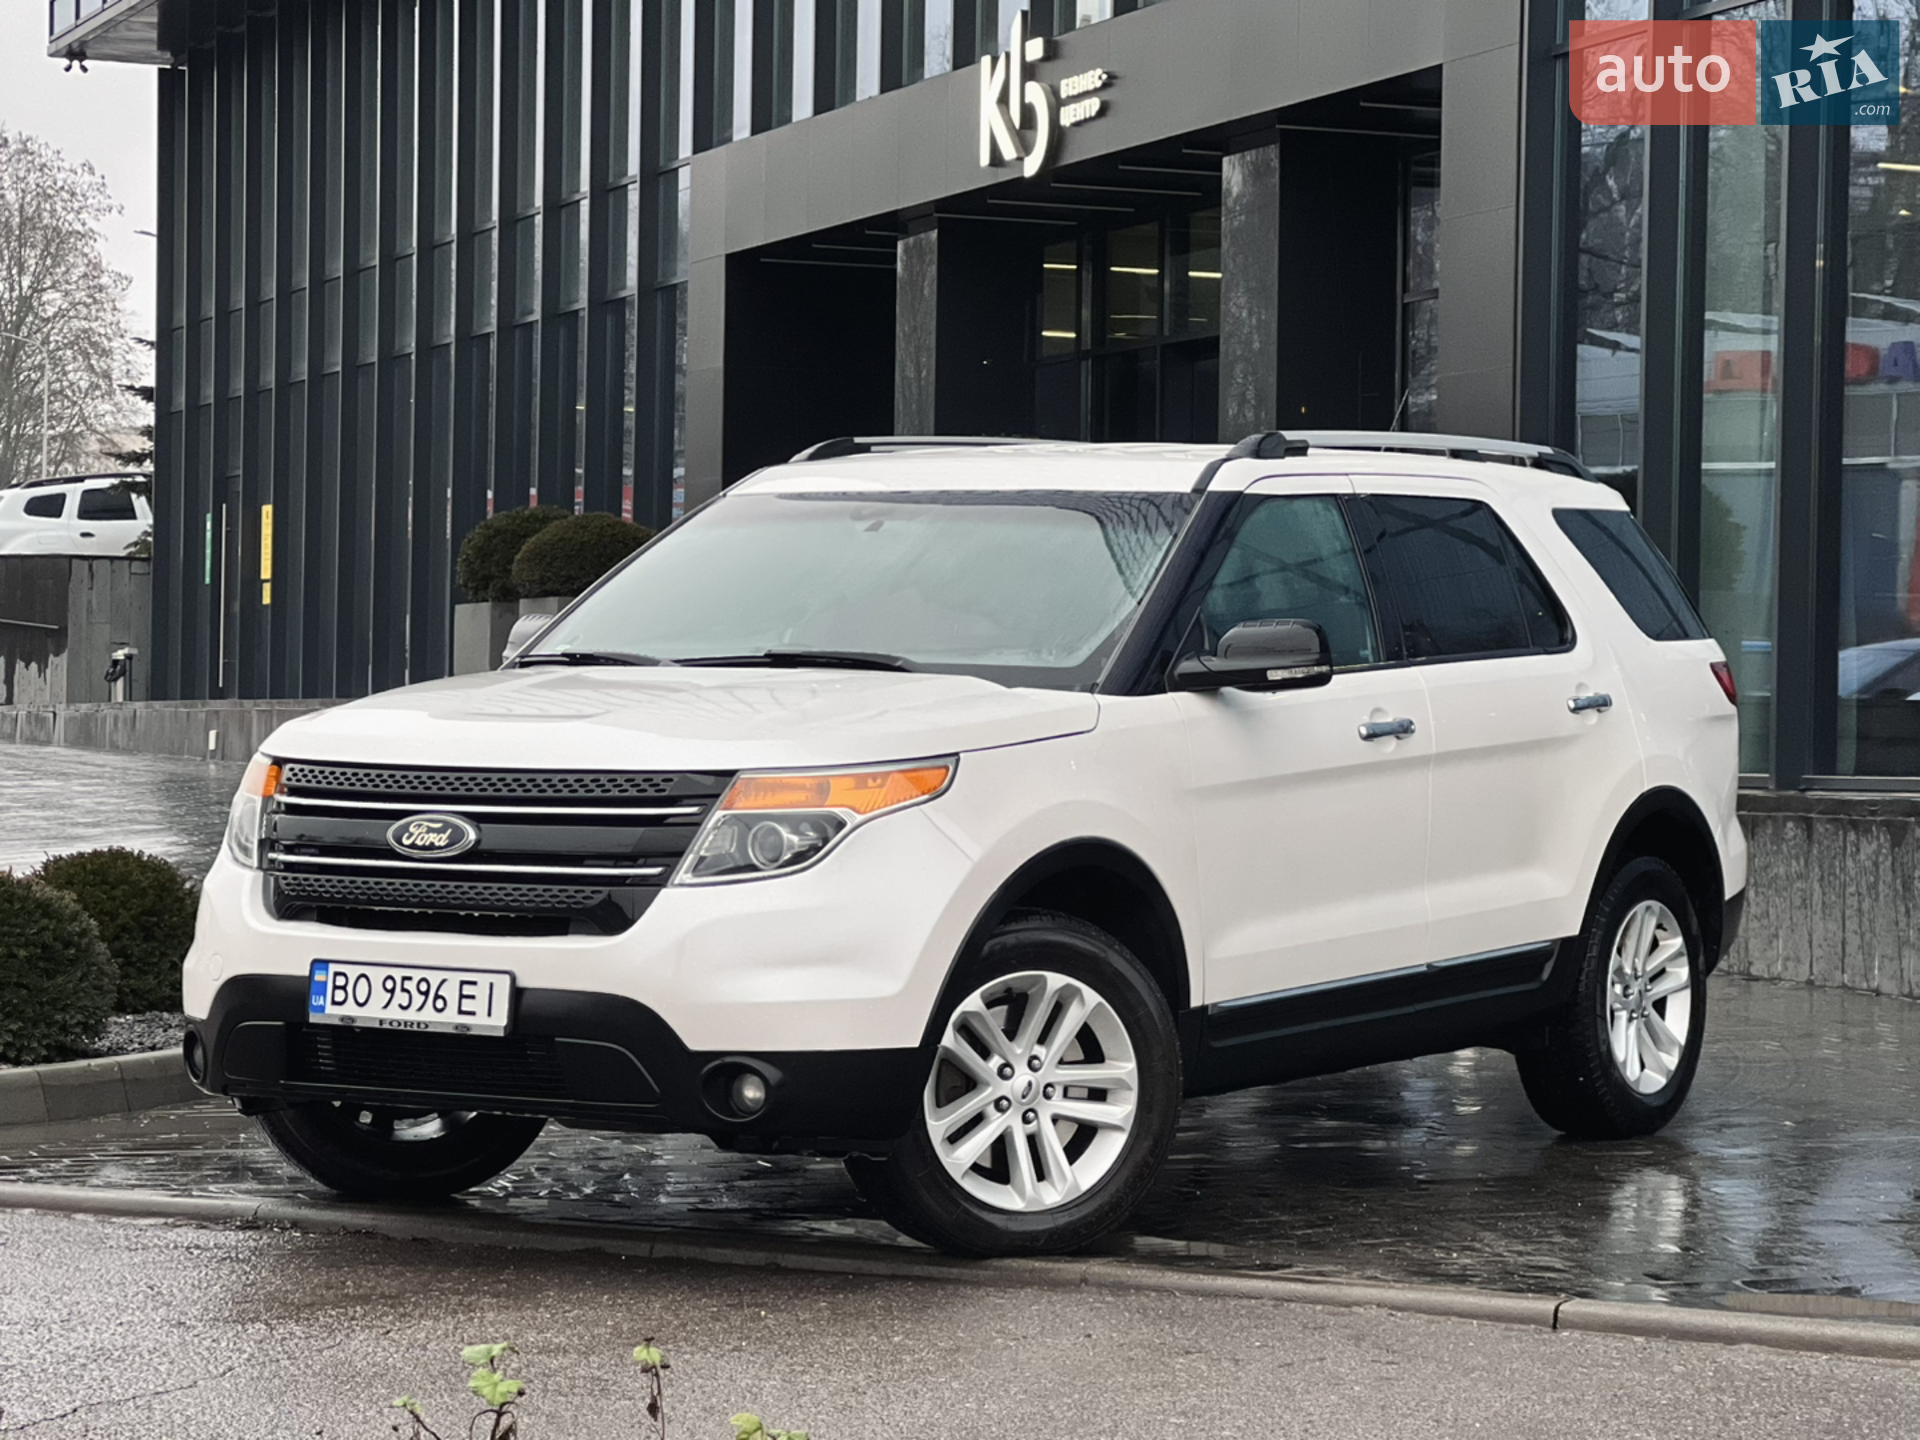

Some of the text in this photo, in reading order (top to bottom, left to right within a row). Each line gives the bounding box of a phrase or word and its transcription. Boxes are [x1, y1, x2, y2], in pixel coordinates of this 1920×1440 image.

[1059, 97, 1101, 127] ЦЕНТР
[402, 821, 452, 847] Ford
[311, 994, 325, 1006] UA
[331, 971, 494, 1018] BO 9596 EI
[378, 1018, 430, 1030] FORD
